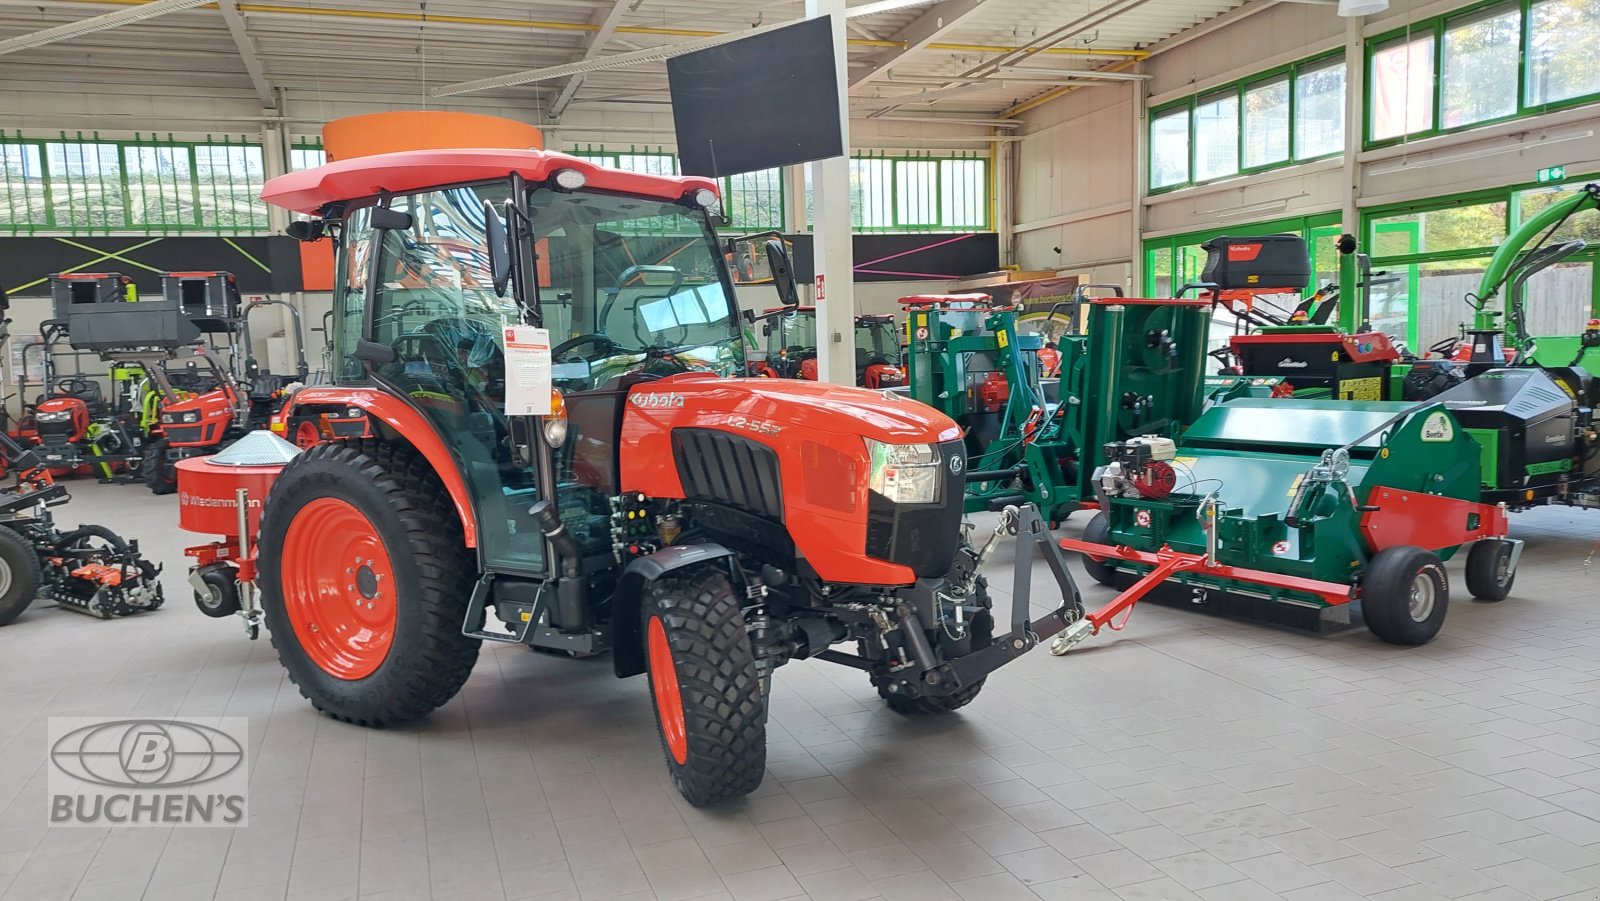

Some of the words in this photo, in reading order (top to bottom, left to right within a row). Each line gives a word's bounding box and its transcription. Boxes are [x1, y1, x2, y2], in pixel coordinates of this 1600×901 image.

[630, 391, 685, 407] Kubota
[727, 415, 782, 437] L2-552
[190, 494, 261, 508] Wiedenmnn
